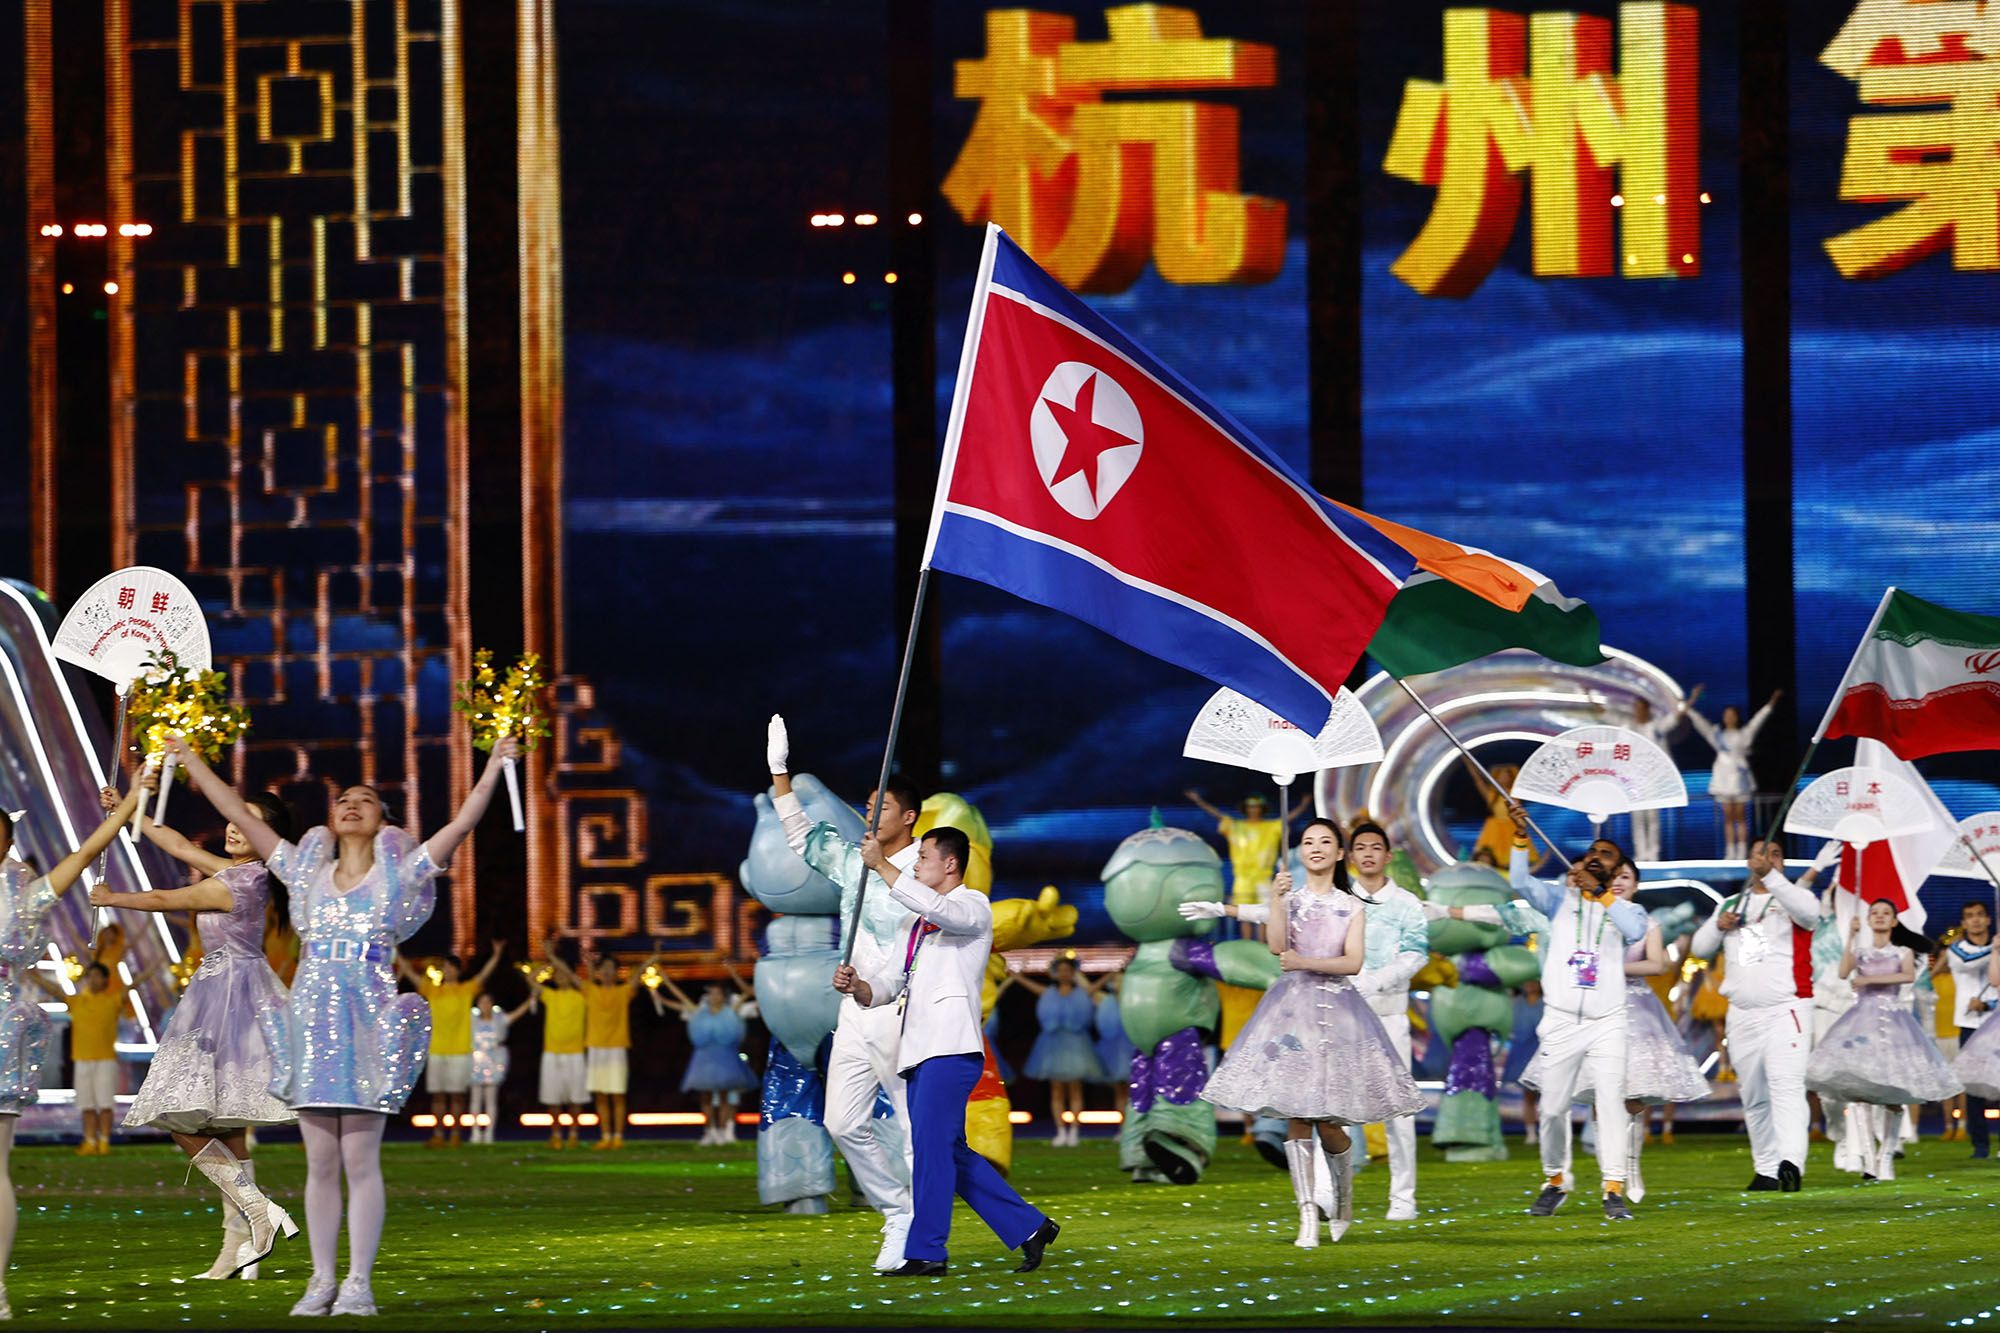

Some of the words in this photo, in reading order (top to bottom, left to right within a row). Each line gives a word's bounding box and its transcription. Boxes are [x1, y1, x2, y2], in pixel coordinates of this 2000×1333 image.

[117, 586, 169, 615] 朝鲜
[88, 618, 127, 657] Democratic
[120, 628, 129, 639] of
[131, 629, 151, 643] Korea
[1836, 781, 1882, 795] 日本
